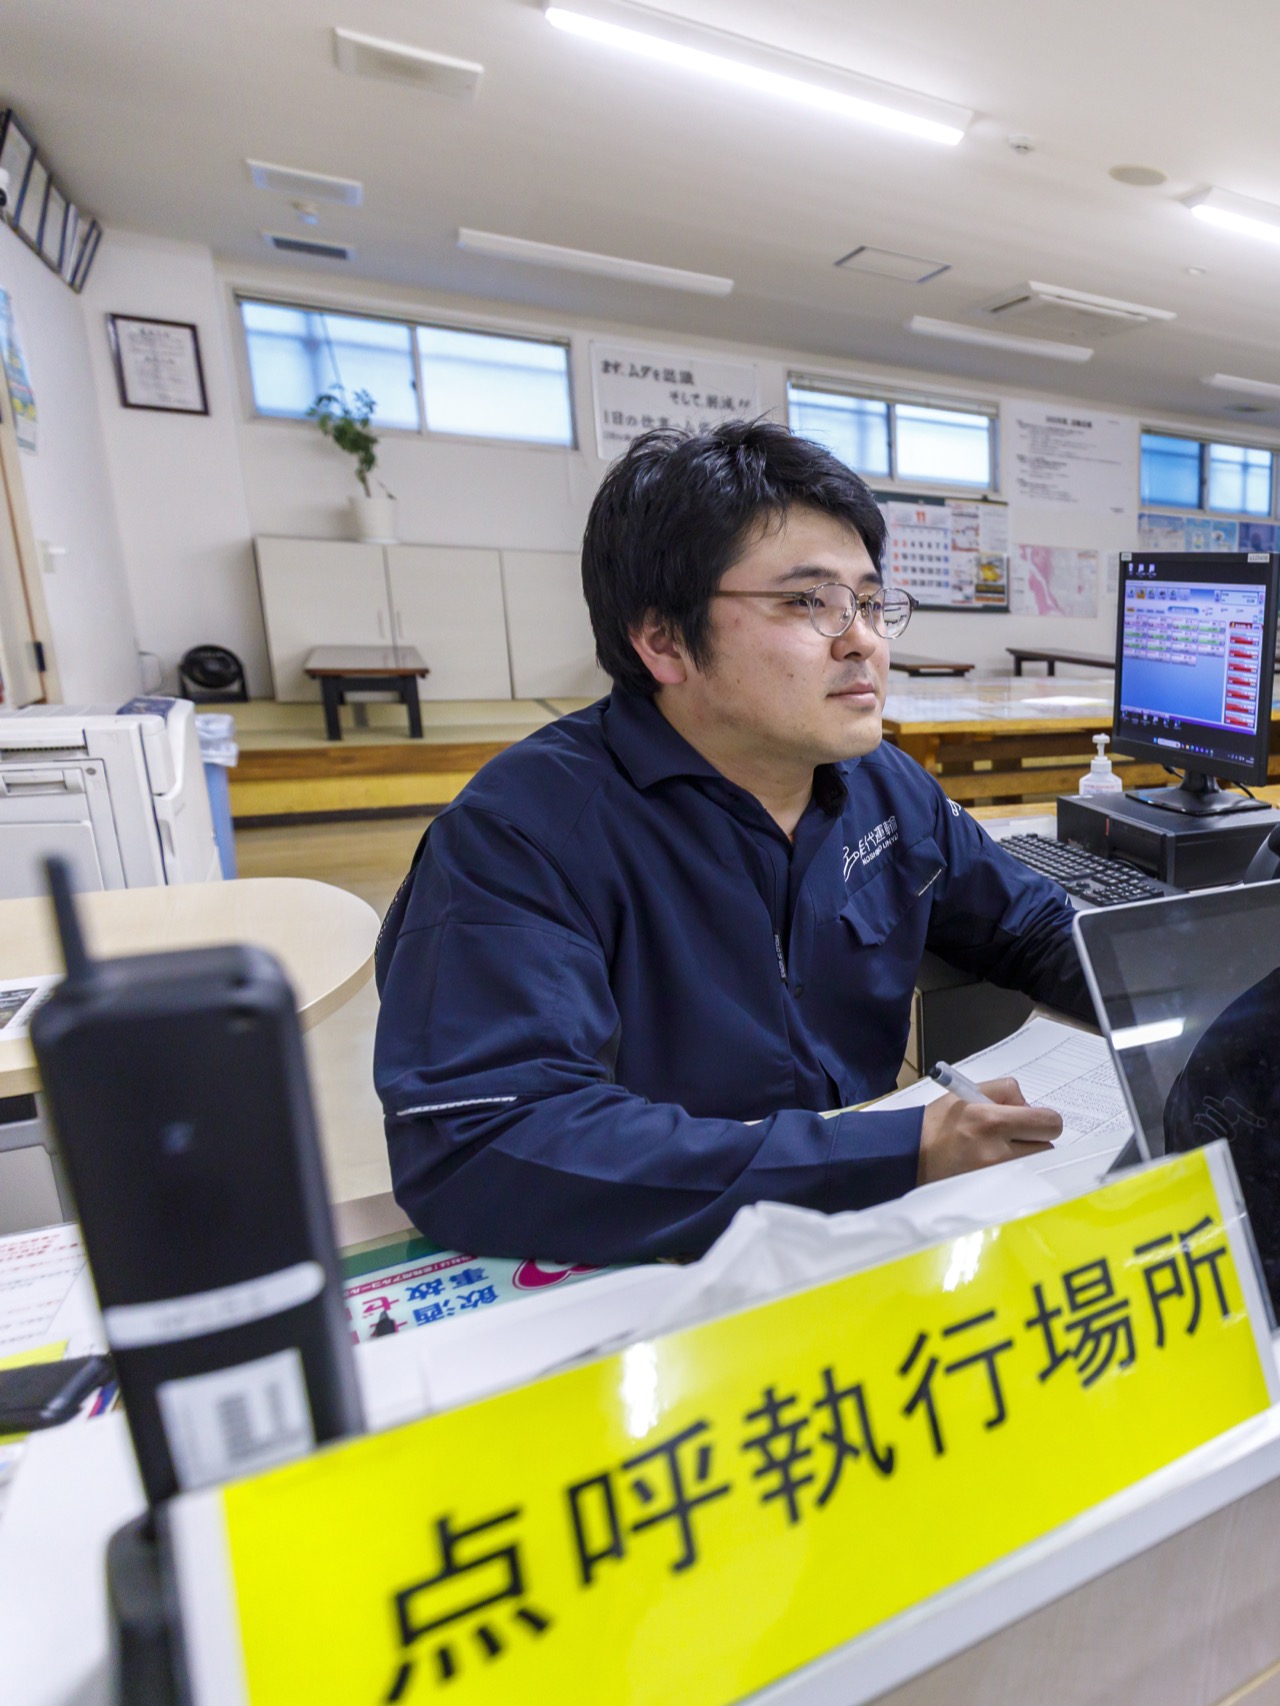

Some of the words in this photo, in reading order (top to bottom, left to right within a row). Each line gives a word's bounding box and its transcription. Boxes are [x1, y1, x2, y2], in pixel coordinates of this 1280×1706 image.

[384, 1216, 1234, 1704] 点呼執行場所
